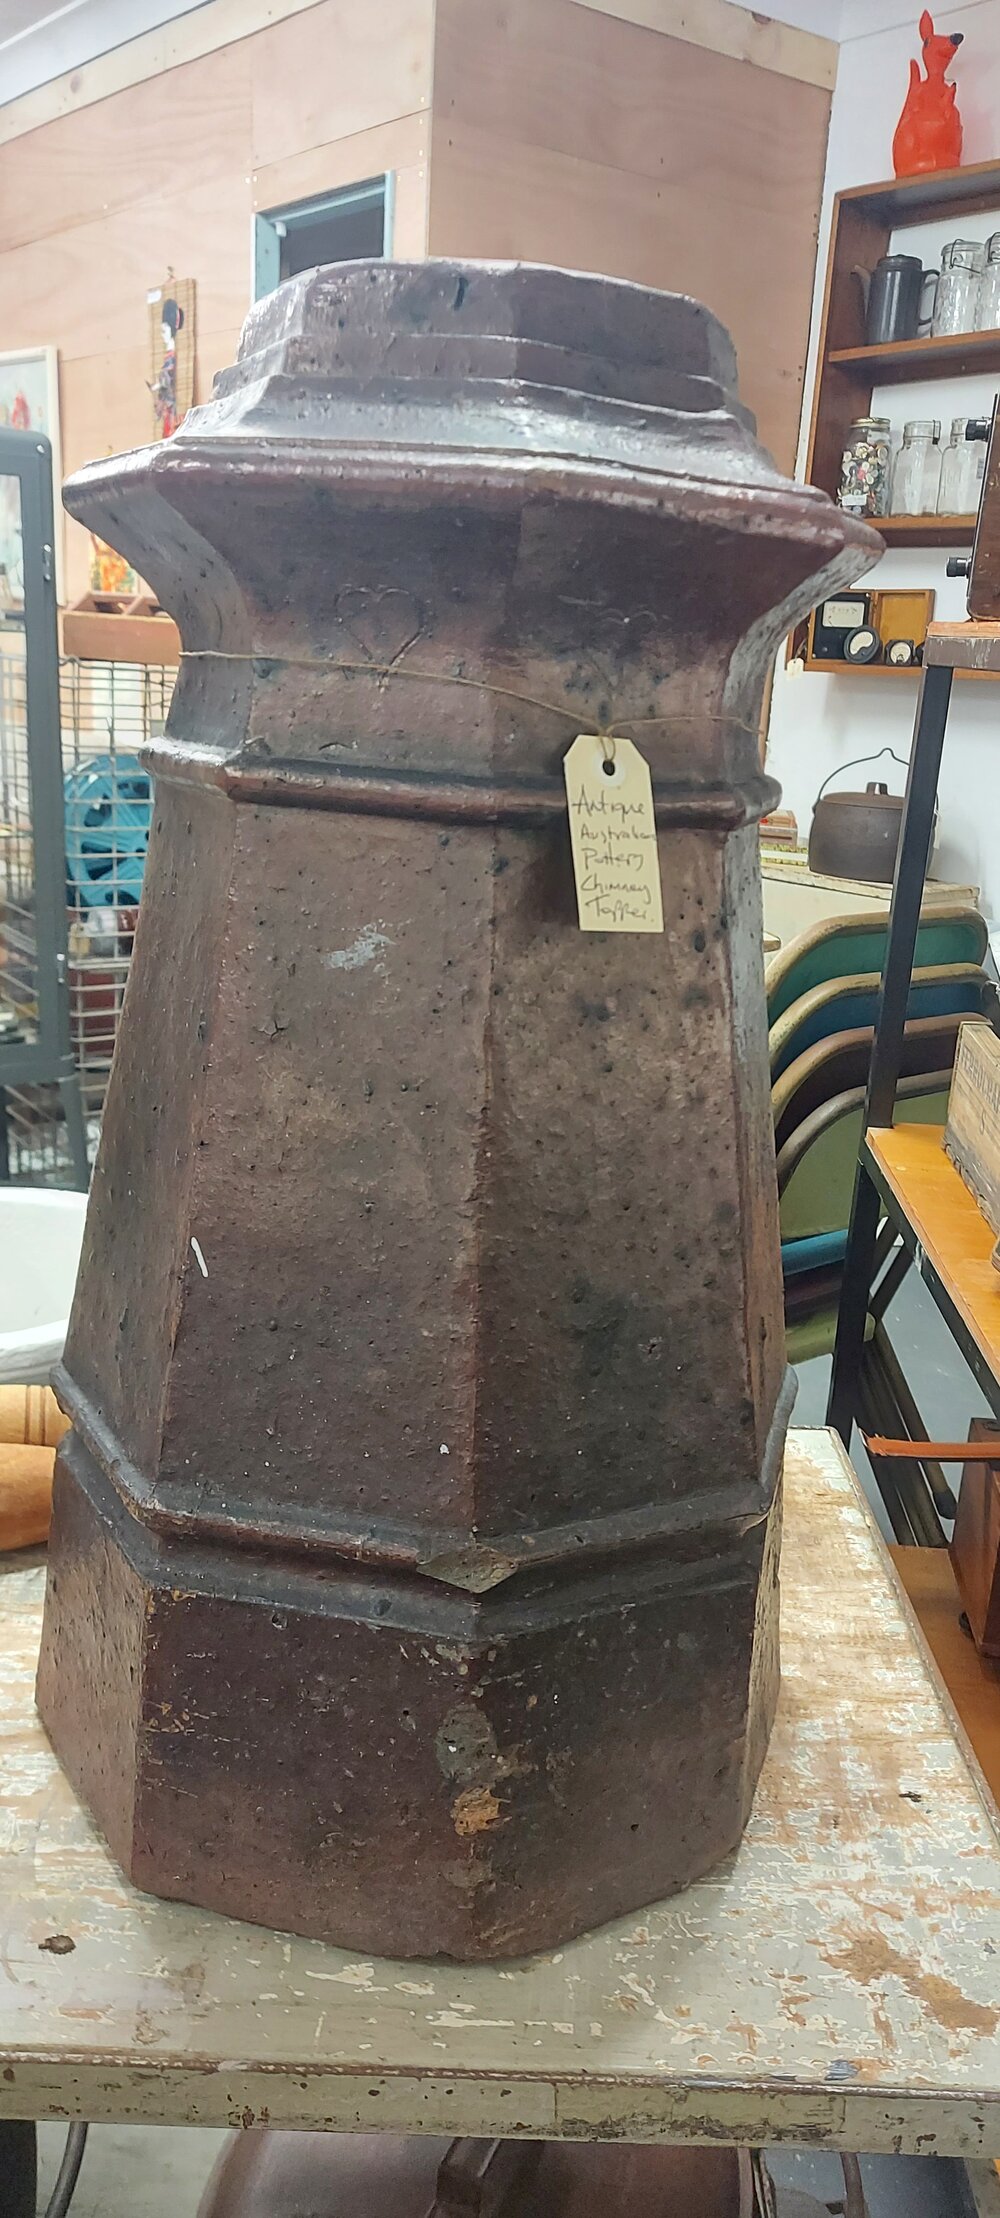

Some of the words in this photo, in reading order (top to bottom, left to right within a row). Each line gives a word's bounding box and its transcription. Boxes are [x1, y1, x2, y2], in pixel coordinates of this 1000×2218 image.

[572, 784, 645, 823] Antique
[581, 842, 644, 871] Pottery
[580, 874, 651, 904] Chimney
